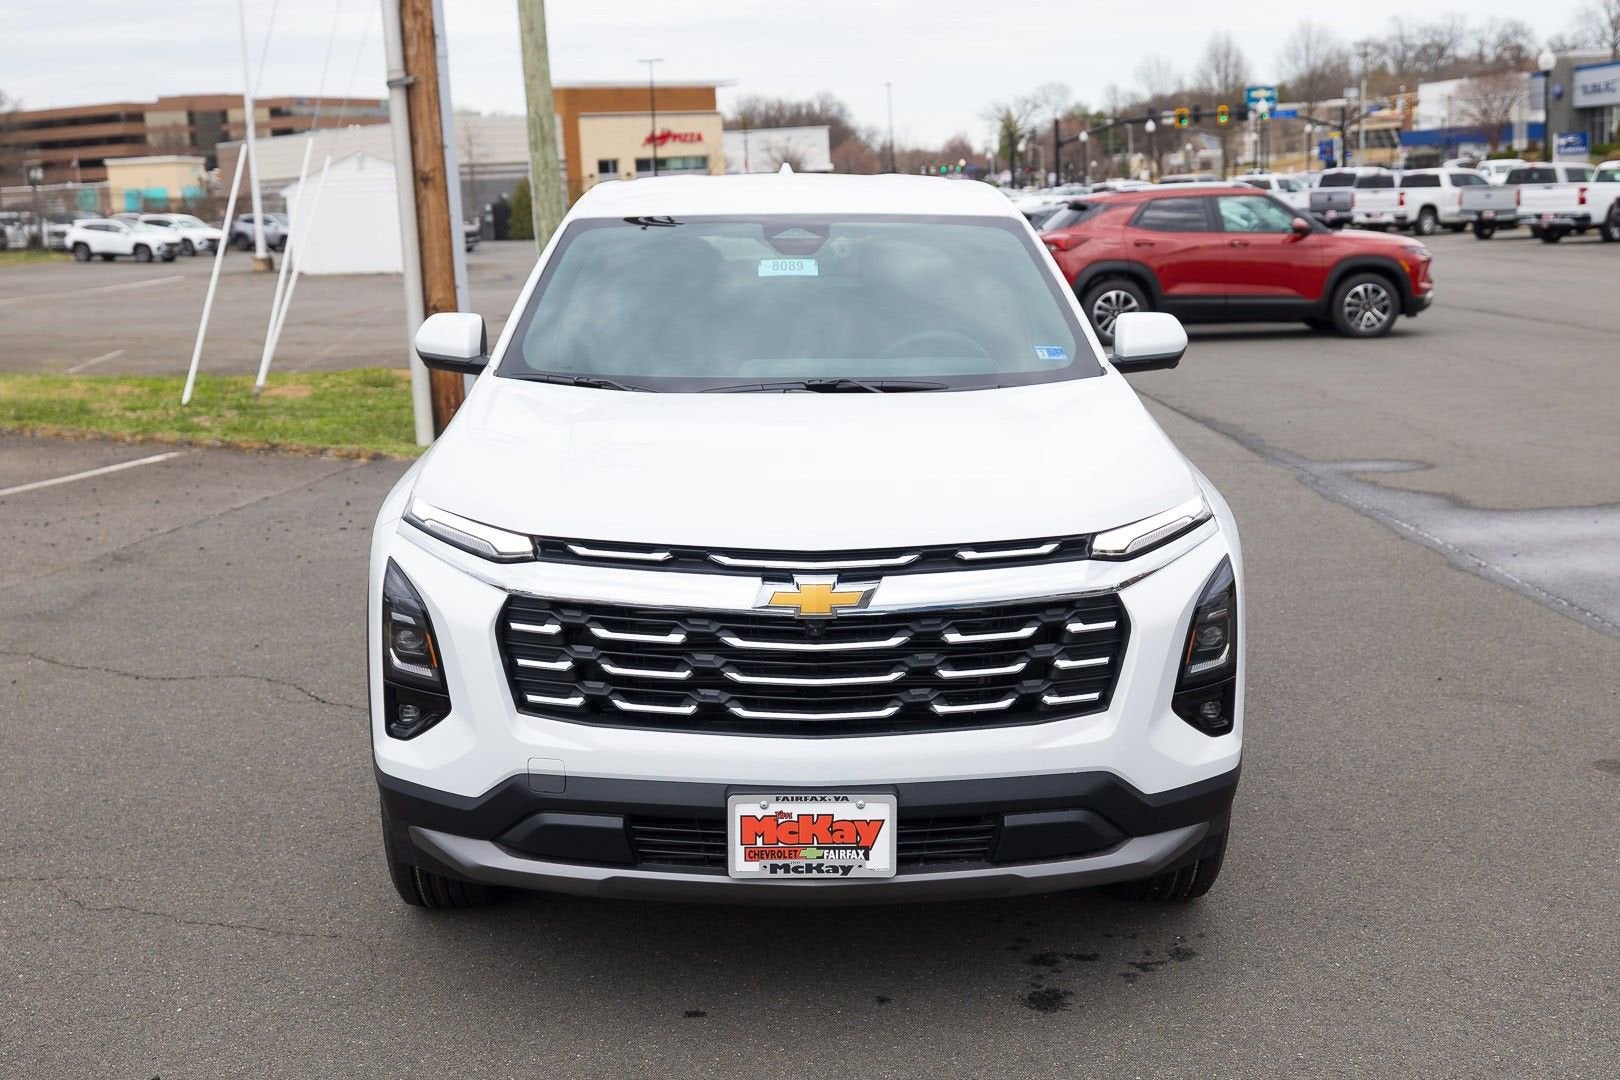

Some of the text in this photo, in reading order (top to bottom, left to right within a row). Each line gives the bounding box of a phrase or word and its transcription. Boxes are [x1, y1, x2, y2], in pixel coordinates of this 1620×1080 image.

[772, 260, 804, 271] 8089
[740, 814, 885, 850] McKay
[748, 849, 865, 860] CHEVROLET FAIRFAX
[769, 862, 855, 876] McKay
